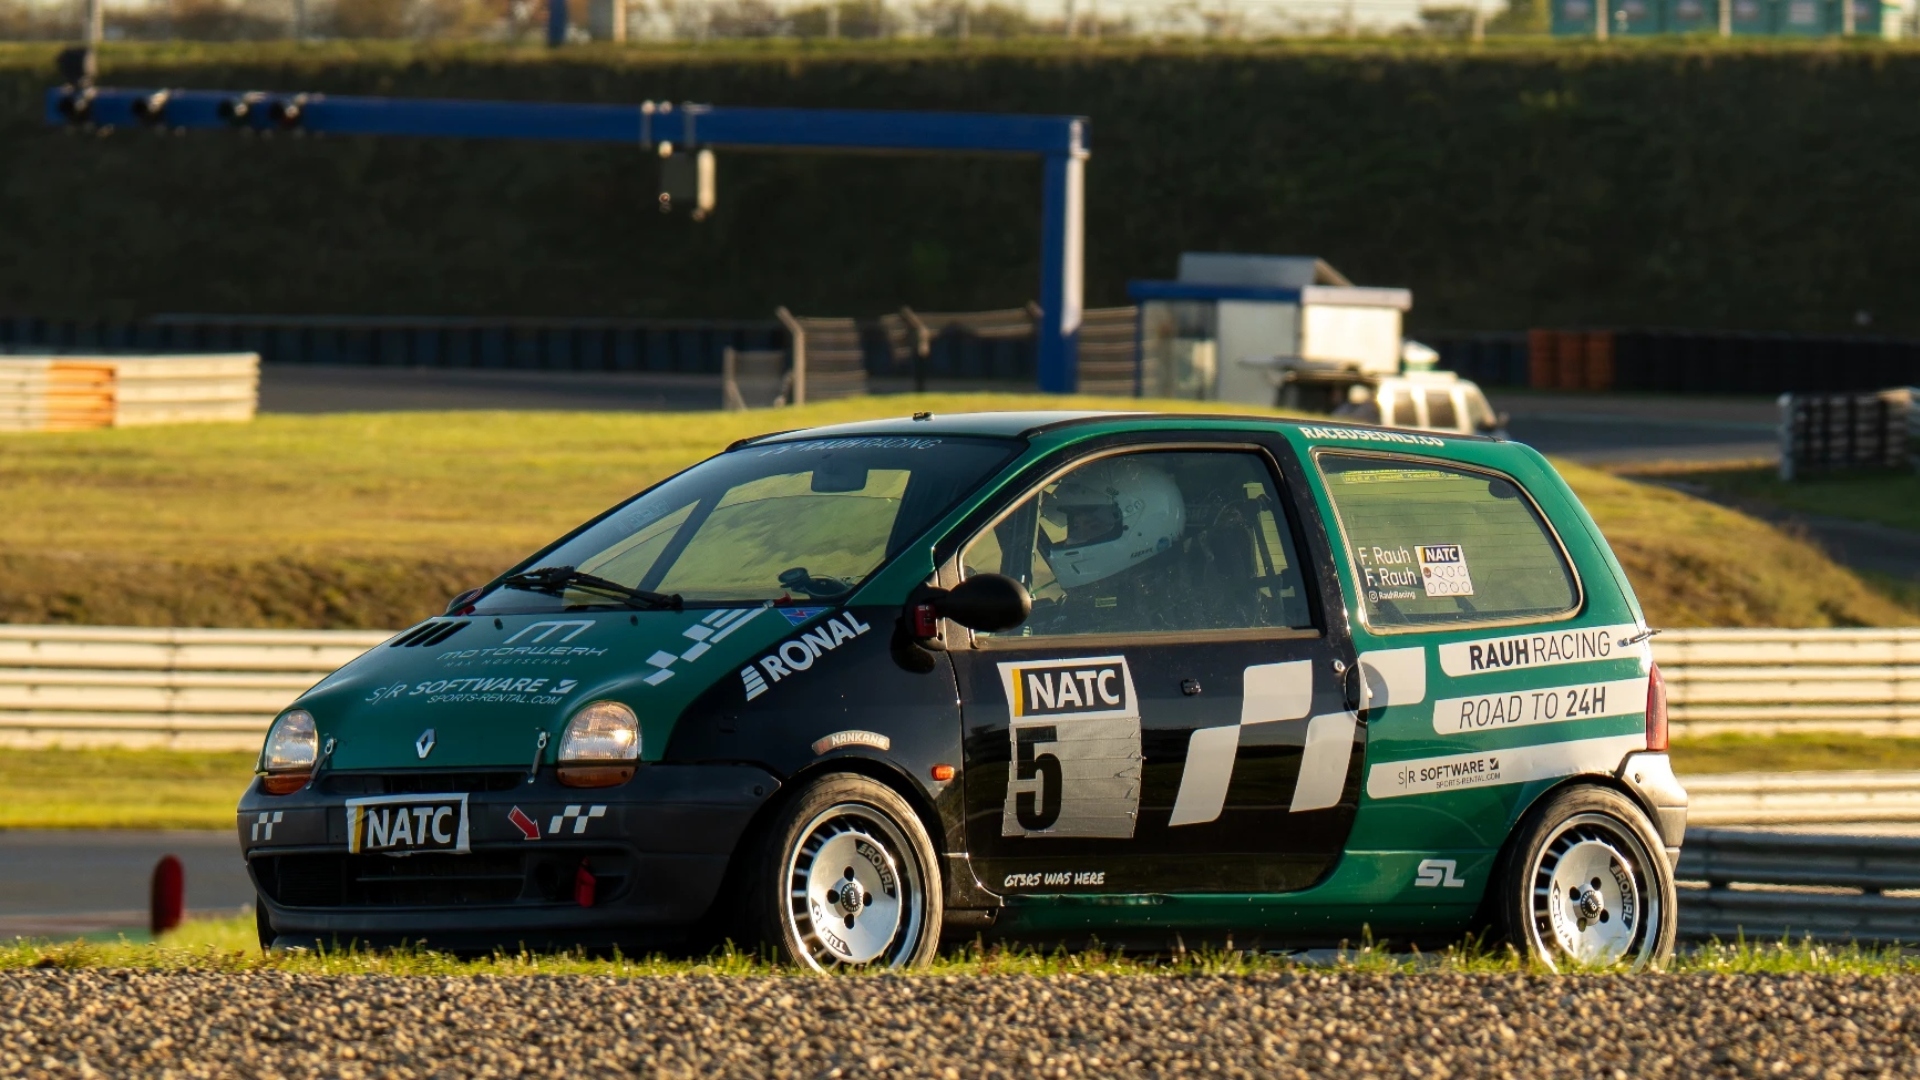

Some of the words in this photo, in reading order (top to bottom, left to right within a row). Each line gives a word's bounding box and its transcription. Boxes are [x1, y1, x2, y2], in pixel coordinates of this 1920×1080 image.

[1358, 547, 1372, 566] F.
[1372, 545, 1411, 565] Rauh
[1425, 547, 1458, 562] NATC
[1364, 568, 1378, 587] F.
[1379, 566, 1417, 586] Rauh
[759, 611, 871, 683] RONAL
[409, 677, 550, 697] SOFTWARE
[1027, 668, 1120, 710] NATC
[427, 693, 563, 706] SPORTS-RENTAL.COM
[1459, 695, 1523, 729] ROAD
[1531, 692, 1559, 720] TO
[1565, 686, 1606, 718] 24H
[831, 732, 887, 746] NANKANG
[1015, 725, 1063, 831] 5
[1420, 760, 1484, 782] SOFTWARE
[1436, 771, 1500, 789] SPORTS-RENTAL.COM
[367, 805, 454, 848] NATC
[864, 848, 894, 894] RONAL
[1004, 873, 1042, 887] GT3RS
[1044, 872, 1072, 885] WAS
[1074, 871, 1105, 885] HERE
[1414, 858, 1465, 888] SL
[1615, 870, 1634, 921] RONAL
